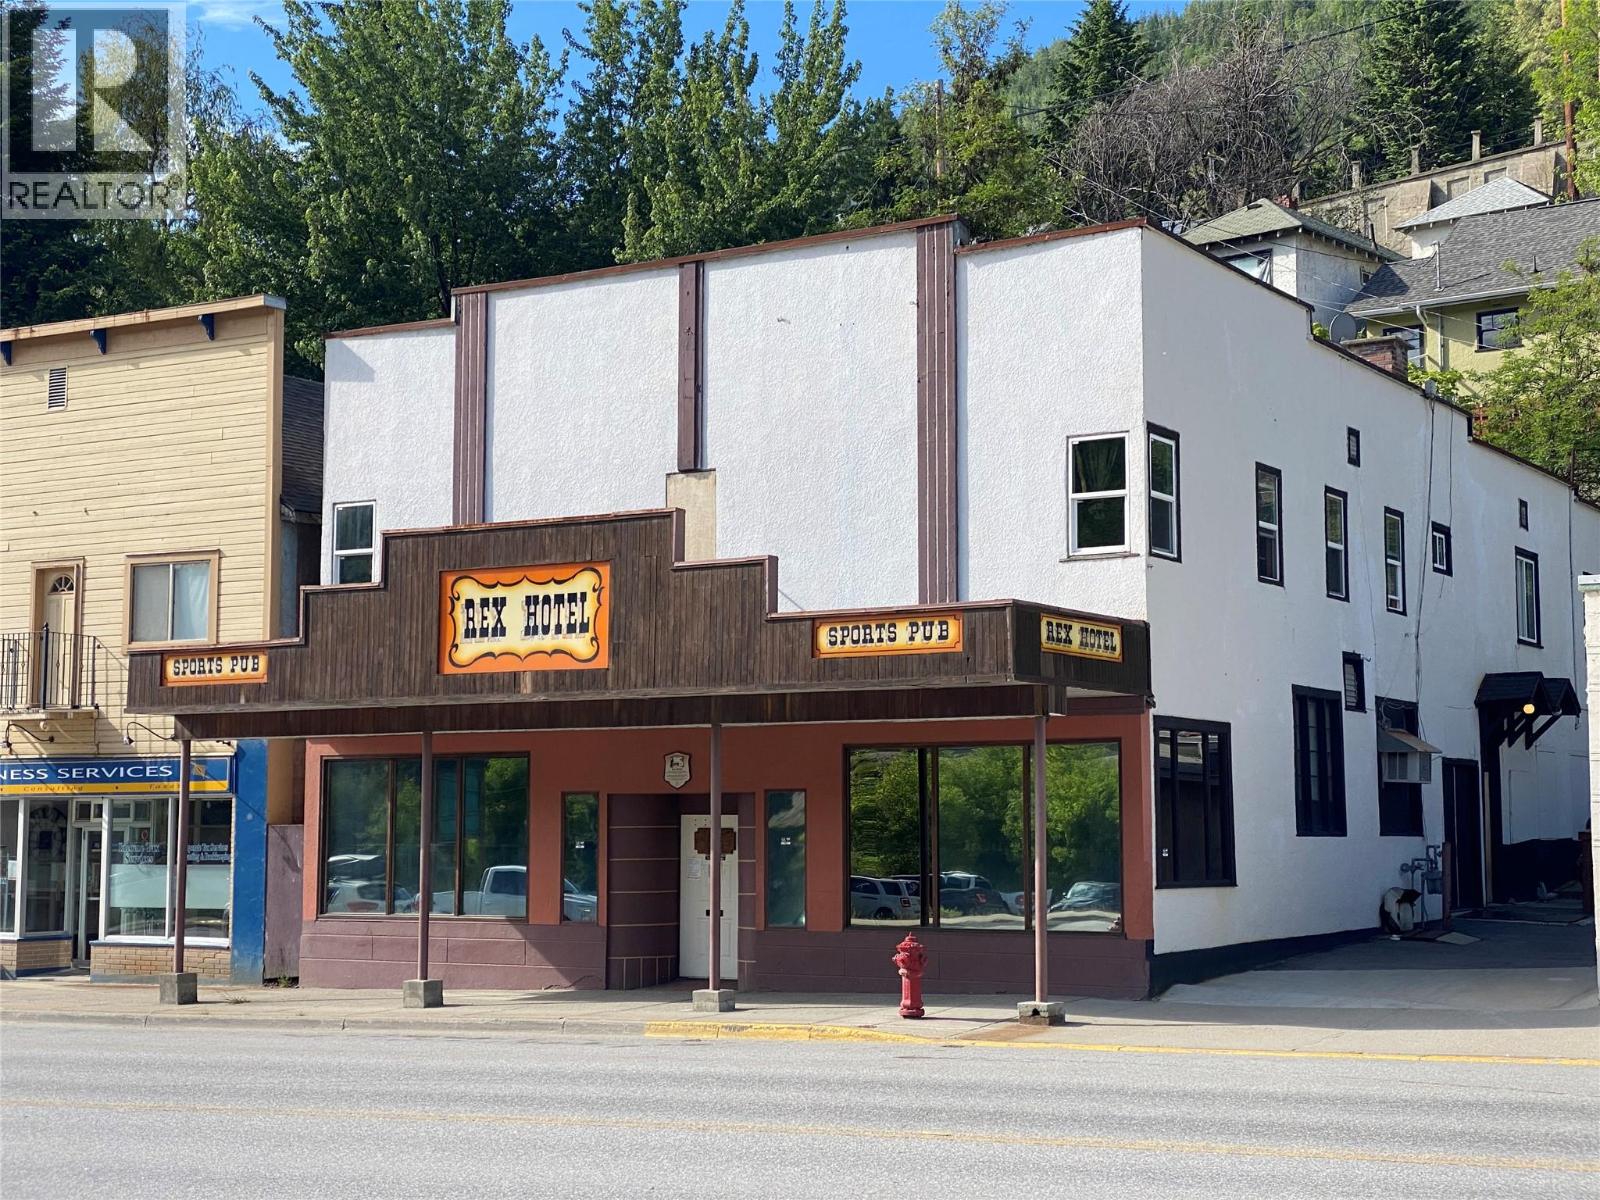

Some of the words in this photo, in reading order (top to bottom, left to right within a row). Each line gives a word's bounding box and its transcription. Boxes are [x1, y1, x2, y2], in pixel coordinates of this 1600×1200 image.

[464, 597, 507, 639] REX
[524, 591, 590, 637] HOTEL
[828, 622, 897, 646] SPORTS
[908, 620, 949, 642] PUB
[1046, 620, 1073, 645] REX
[1079, 626, 1117, 652] HOTEL
[173, 656, 223, 676] SPORTS
[230, 655, 260, 673] PUB
[57, 765, 173, 779] SERVICES
